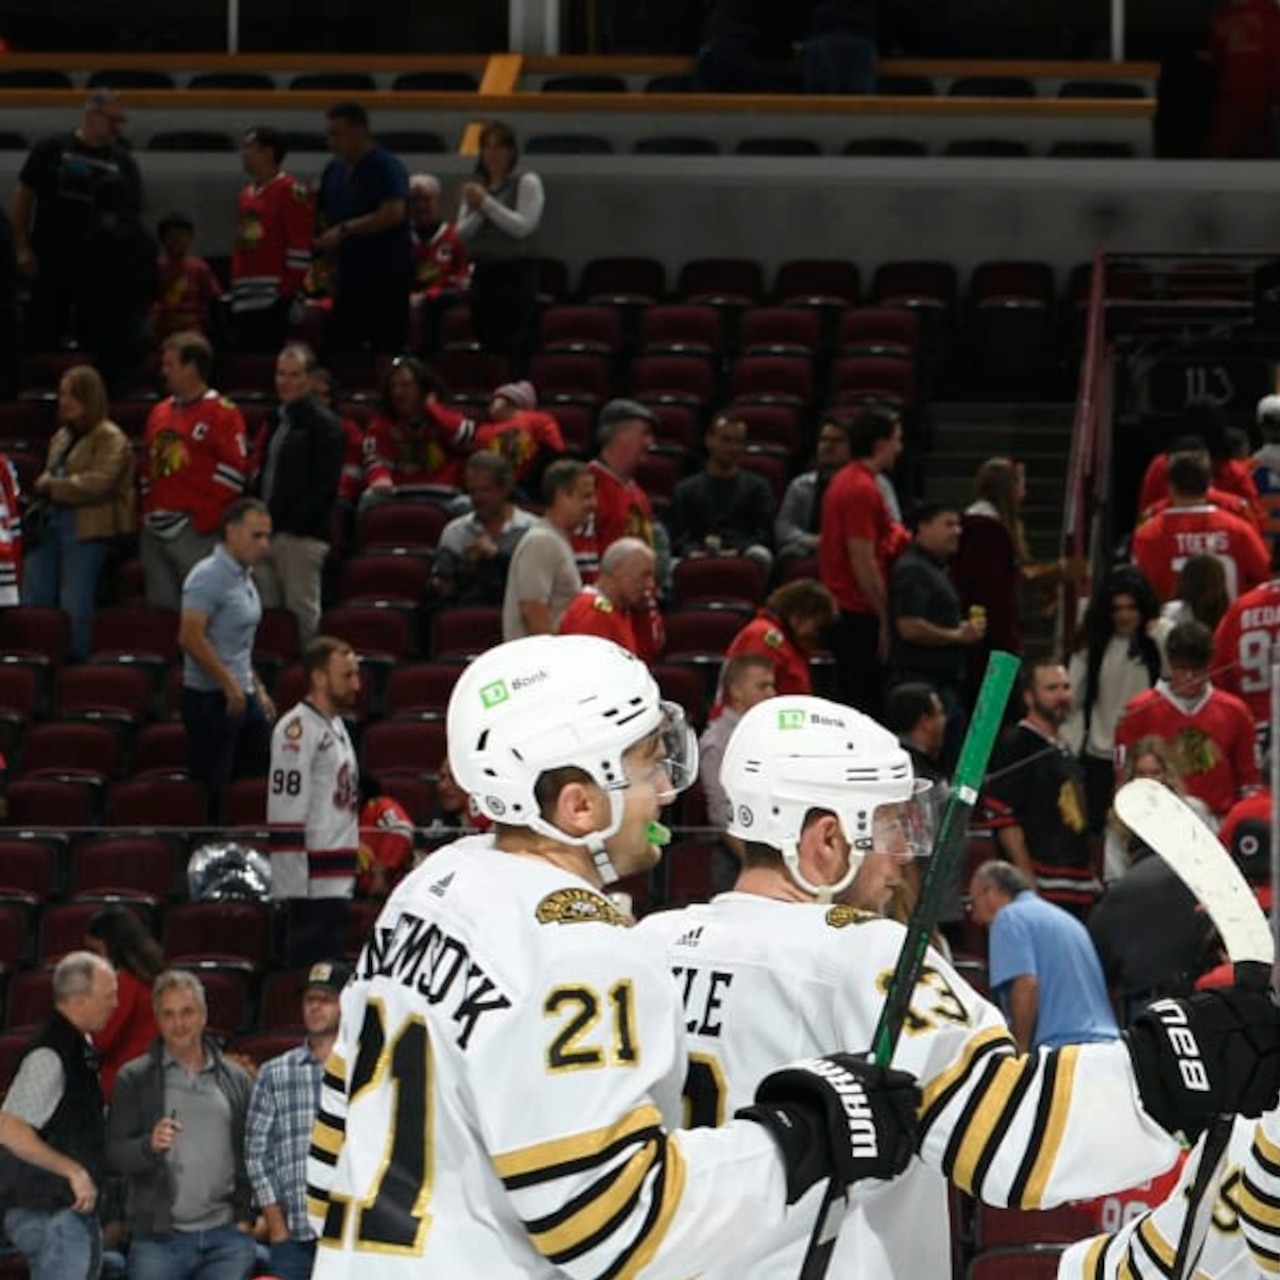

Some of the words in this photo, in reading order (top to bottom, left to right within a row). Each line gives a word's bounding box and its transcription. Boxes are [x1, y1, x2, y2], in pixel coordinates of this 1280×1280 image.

[1186, 367, 1231, 403] 113
[272, 770, 302, 796] 98
[543, 978, 639, 1076] 21
